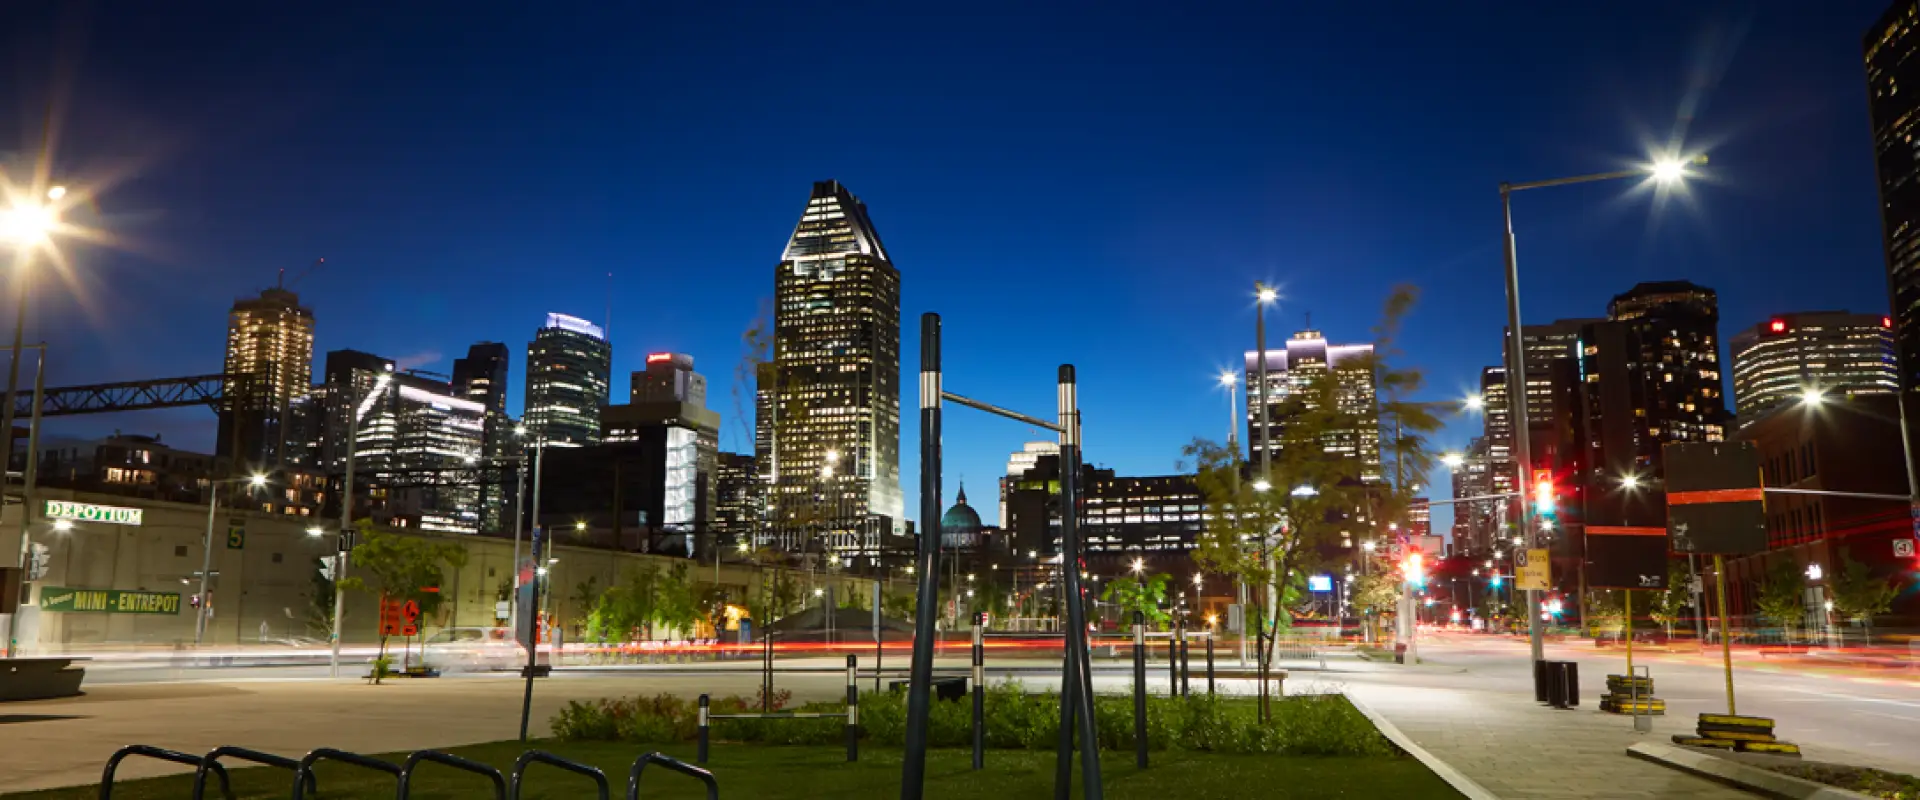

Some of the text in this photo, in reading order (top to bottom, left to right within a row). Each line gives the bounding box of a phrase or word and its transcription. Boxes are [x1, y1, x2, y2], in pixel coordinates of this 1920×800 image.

[47, 501, 142, 523] DEPOTIUM
[230, 527, 243, 547] 5
[74, 591, 107, 610] MINI
[118, 592, 179, 612] ENTREPOT
